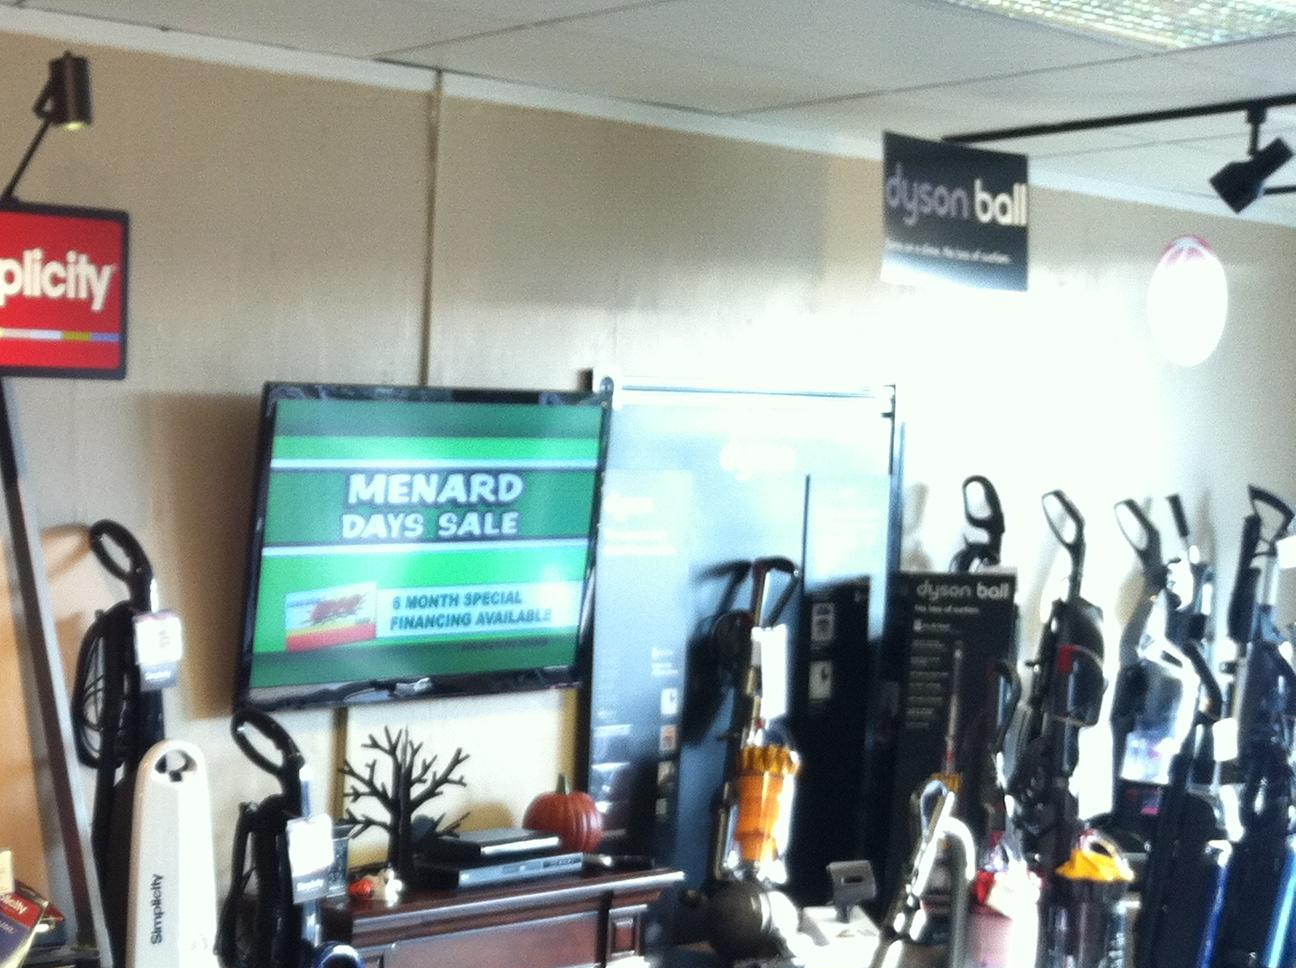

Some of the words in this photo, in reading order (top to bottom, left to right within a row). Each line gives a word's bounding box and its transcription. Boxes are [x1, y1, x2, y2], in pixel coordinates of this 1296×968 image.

[886, 161, 969, 226] dyson
[974, 178, 1027, 226] ball
[348, 472, 524, 504] MENARD
[341, 512, 425, 539] DAYS
[437, 511, 519, 536] SALE
[405, 593, 460, 609] MONTH
[464, 590, 522, 606] SPECIAL
[916, 579, 972, 601] dyson
[976, 581, 1010, 600] ball
[390, 612, 472, 630] FINANCING
[475, 608, 553, 626] AVAILABLE
[150, 873, 165, 945] Simplicity
